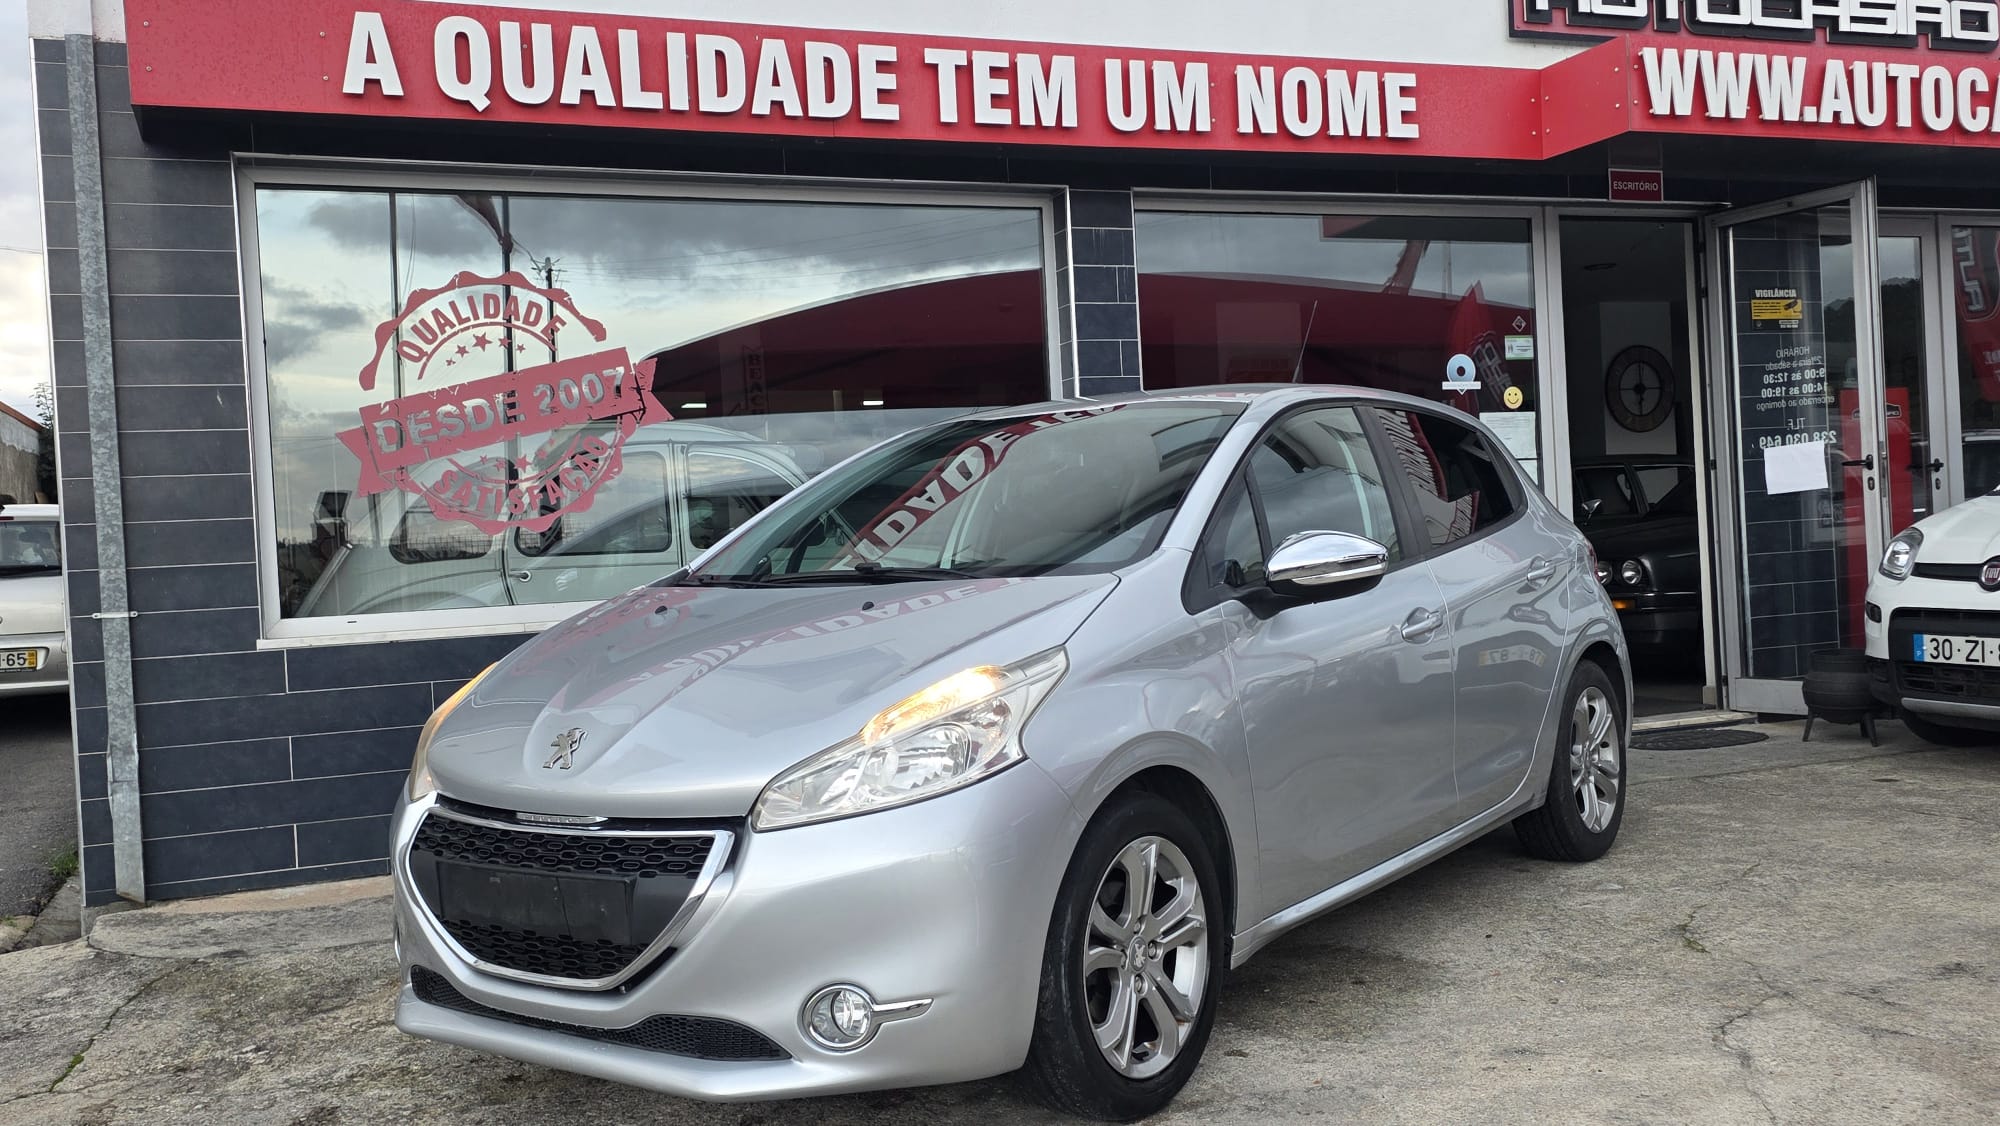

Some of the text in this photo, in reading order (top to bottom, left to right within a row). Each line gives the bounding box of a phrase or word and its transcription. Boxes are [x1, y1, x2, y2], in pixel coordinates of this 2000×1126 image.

[342, 11, 1420, 139] A QUALIDADE TEM UM NOME
[1613, 180, 1659, 192] ESCRITÓRIO
[397, 292, 568, 364] QUALIDADE
[1754, 287, 1798, 298] VIGILÂNCIA
[372, 366, 626, 455] DESDE 2007
